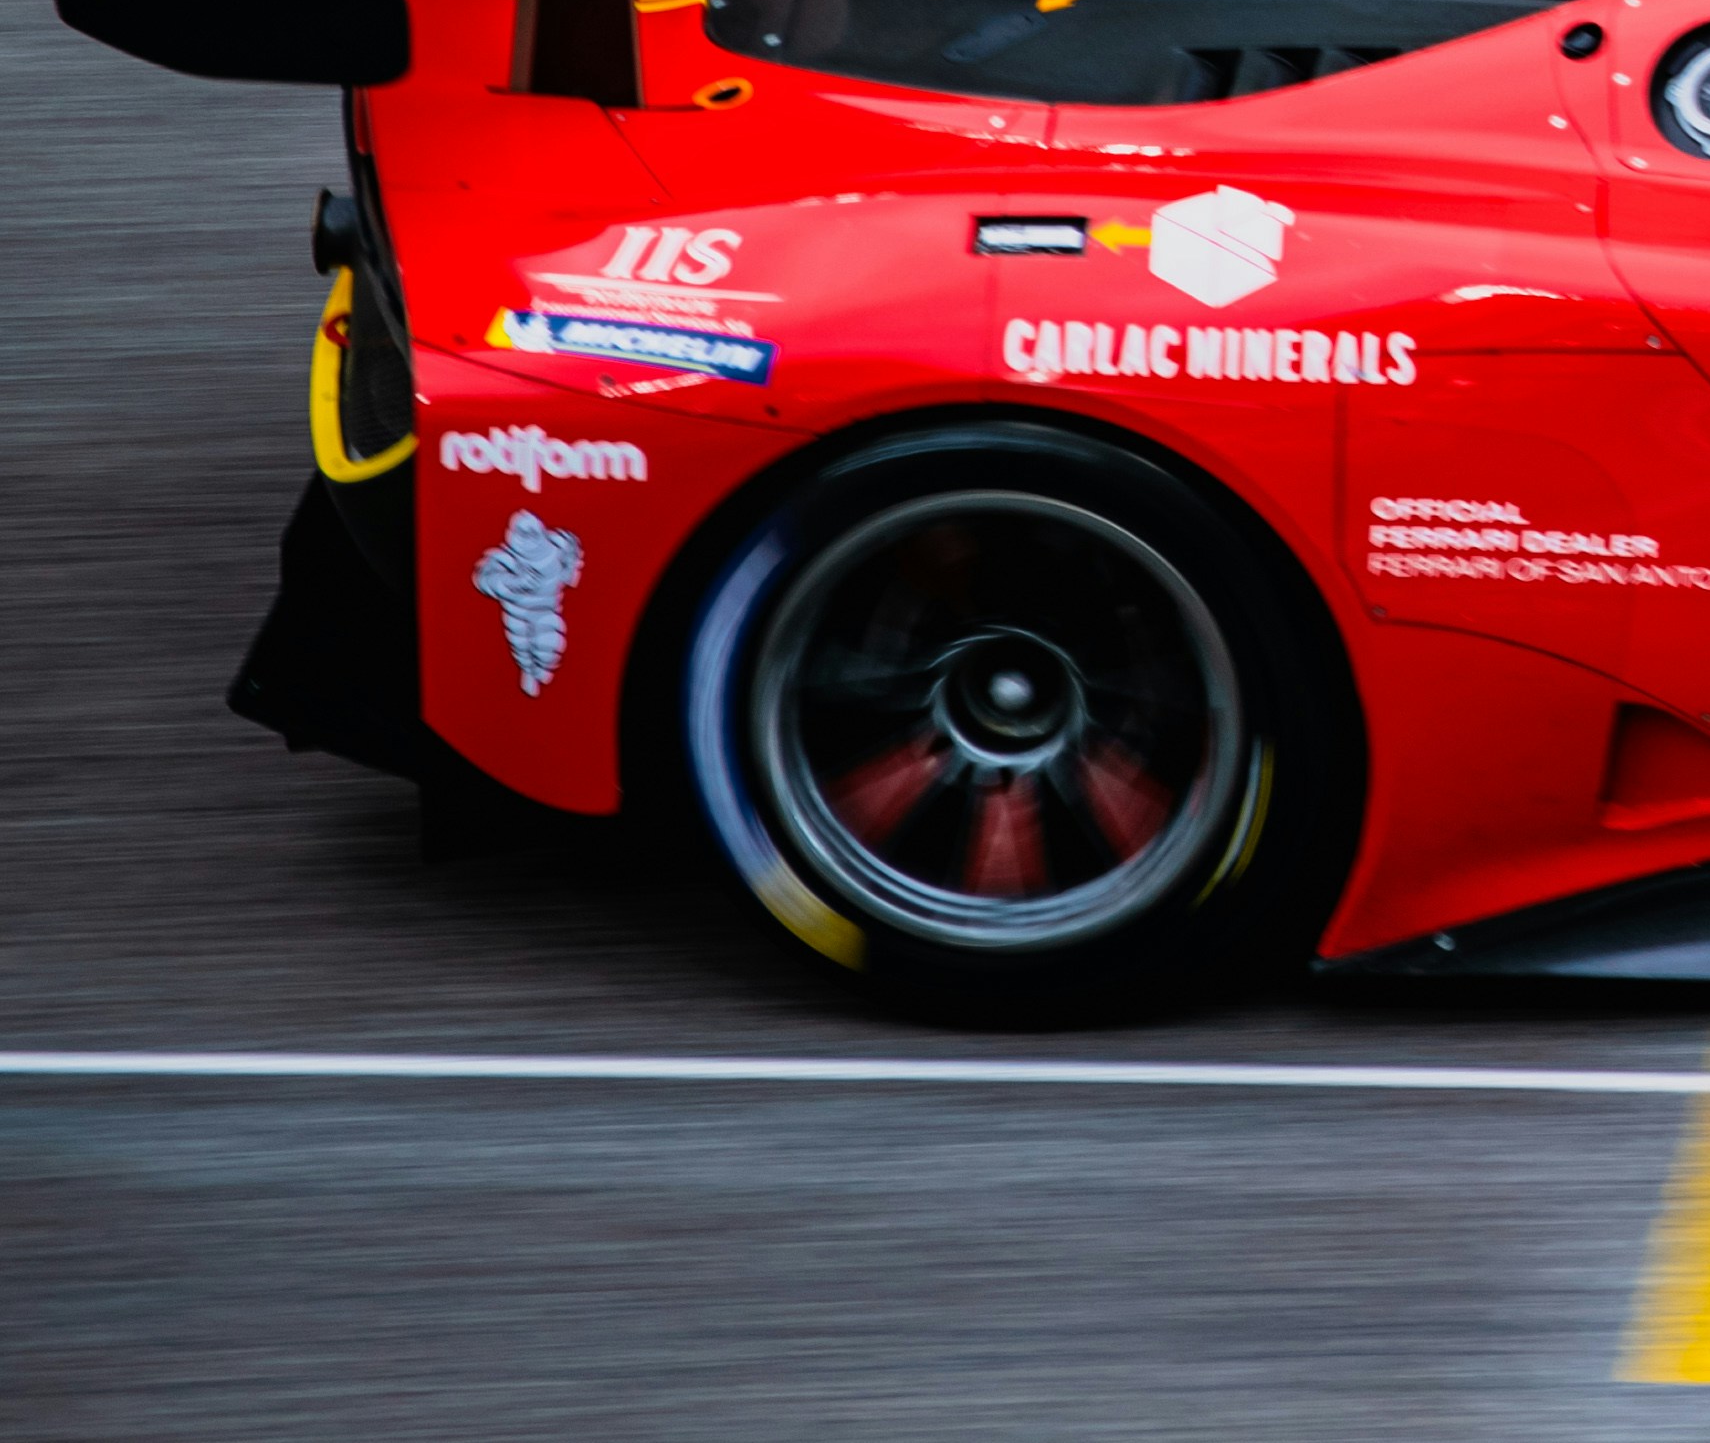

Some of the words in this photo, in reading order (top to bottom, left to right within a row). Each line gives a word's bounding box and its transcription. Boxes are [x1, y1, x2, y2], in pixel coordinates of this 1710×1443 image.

[599, 226, 743, 285] IIS
[1003, 318, 1181, 378] CARLAC
[1187, 326, 1417, 385] MINERALS
[440, 424, 647, 493] rotiform
[1370, 496, 1530, 525] OFFICIAL
[1369, 525, 1518, 552] FERRARI
[1521, 530, 1659, 558] DEALER
[1367, 552, 1505, 579] FERRARI
[1507, 557, 1556, 582] OF
[1555, 560, 1628, 584] SAN
